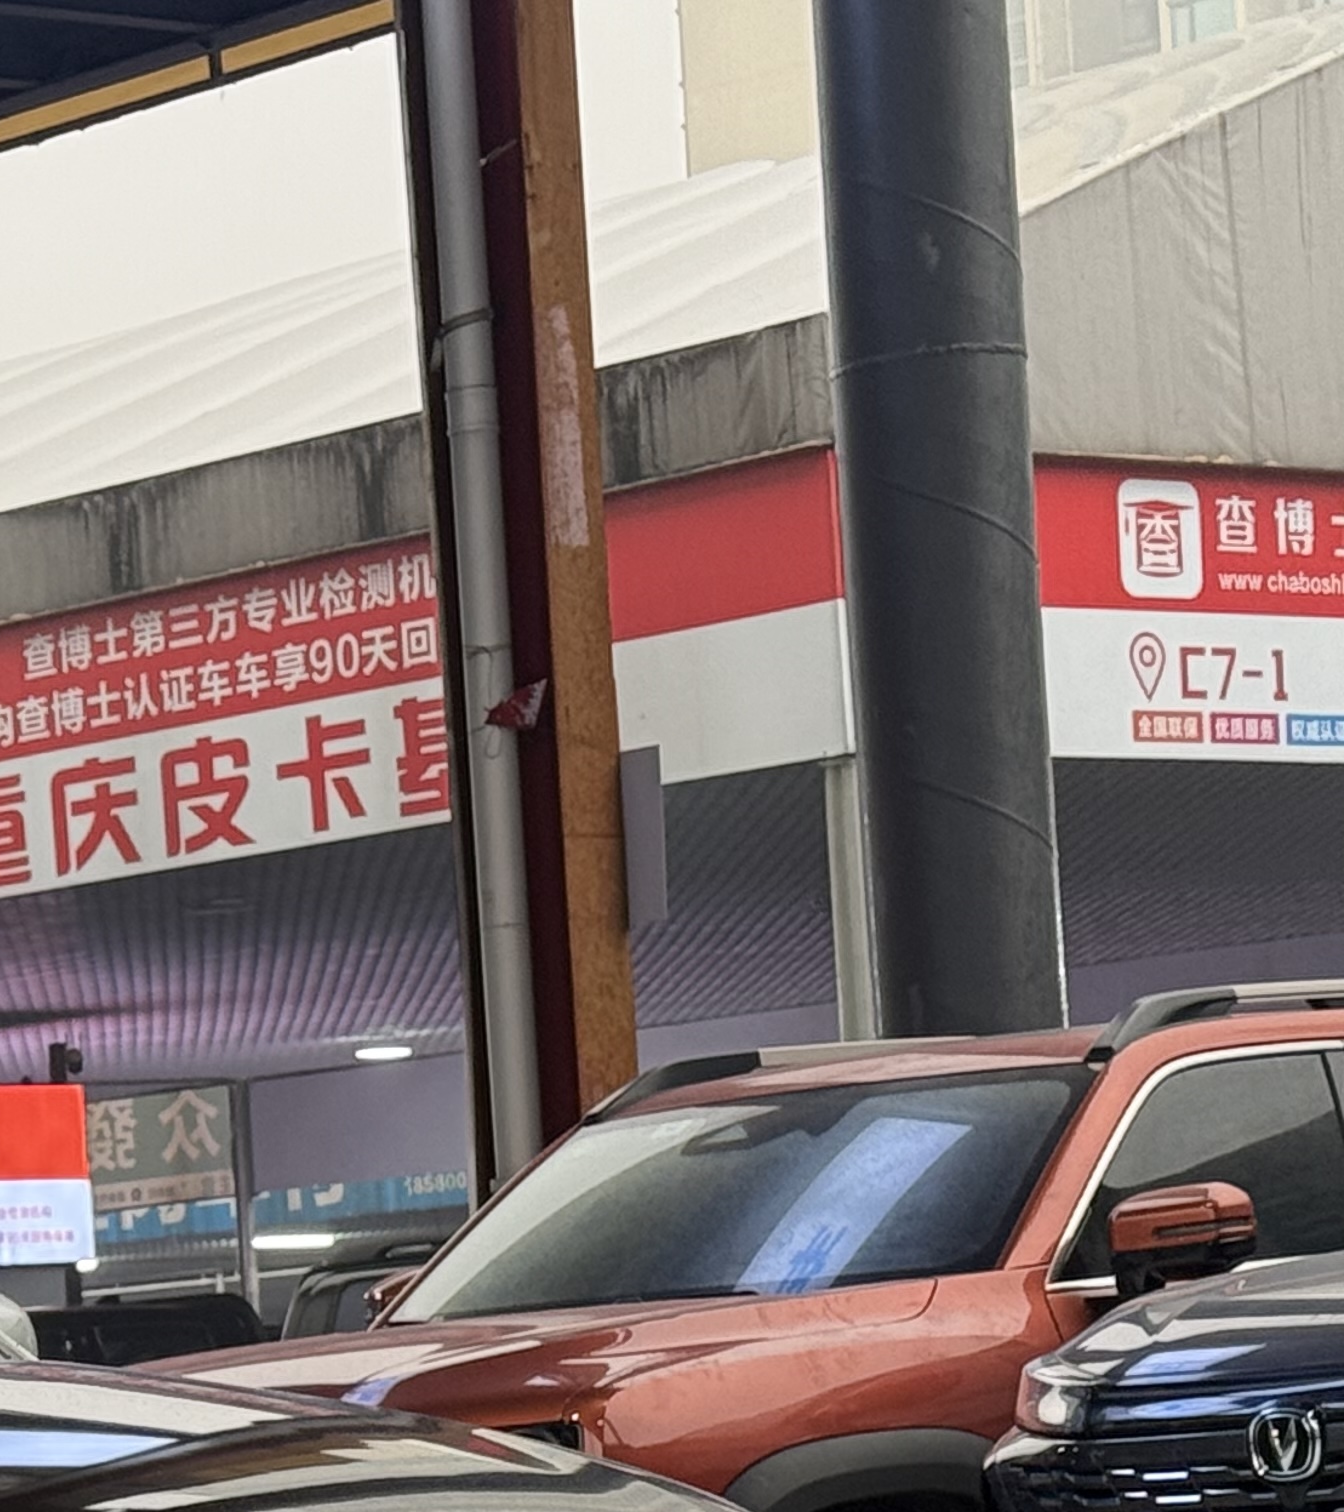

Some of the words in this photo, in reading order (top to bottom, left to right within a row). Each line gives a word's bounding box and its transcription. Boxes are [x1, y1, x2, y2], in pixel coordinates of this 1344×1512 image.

[21, 552, 438, 682] 查博士第三方专业检测机
[1178, 645, 1289, 702] C7-1
